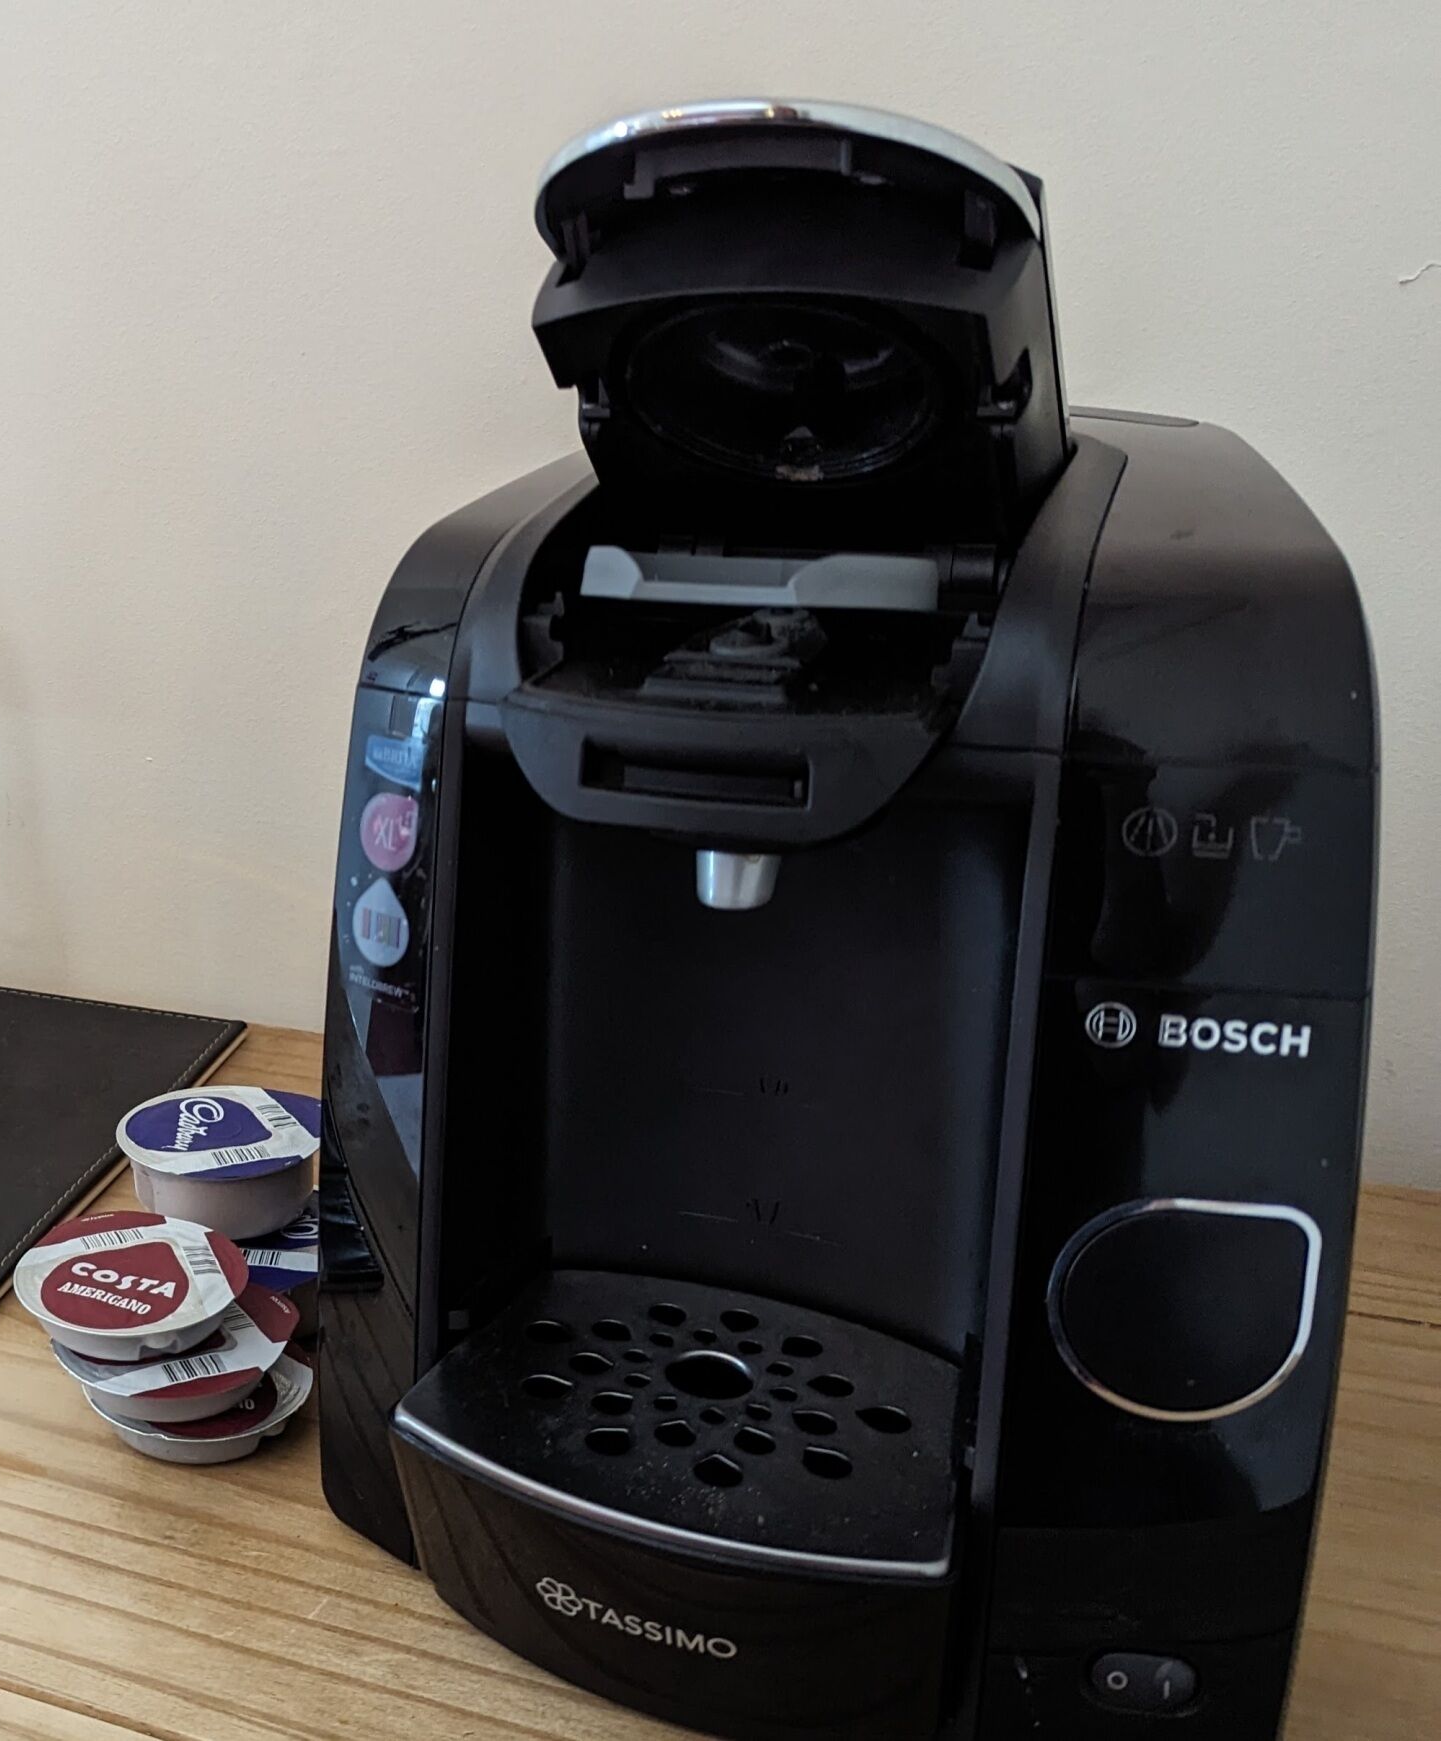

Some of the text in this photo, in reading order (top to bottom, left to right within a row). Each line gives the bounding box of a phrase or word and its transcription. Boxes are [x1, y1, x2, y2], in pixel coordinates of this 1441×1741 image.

[1157, 1013, 1312, 1058] BOSCH
[56, 1280, 153, 1316] AMERICANO
[68, 1260, 178, 1299] COSTA
[579, 1599, 738, 1659] TASSIMO
